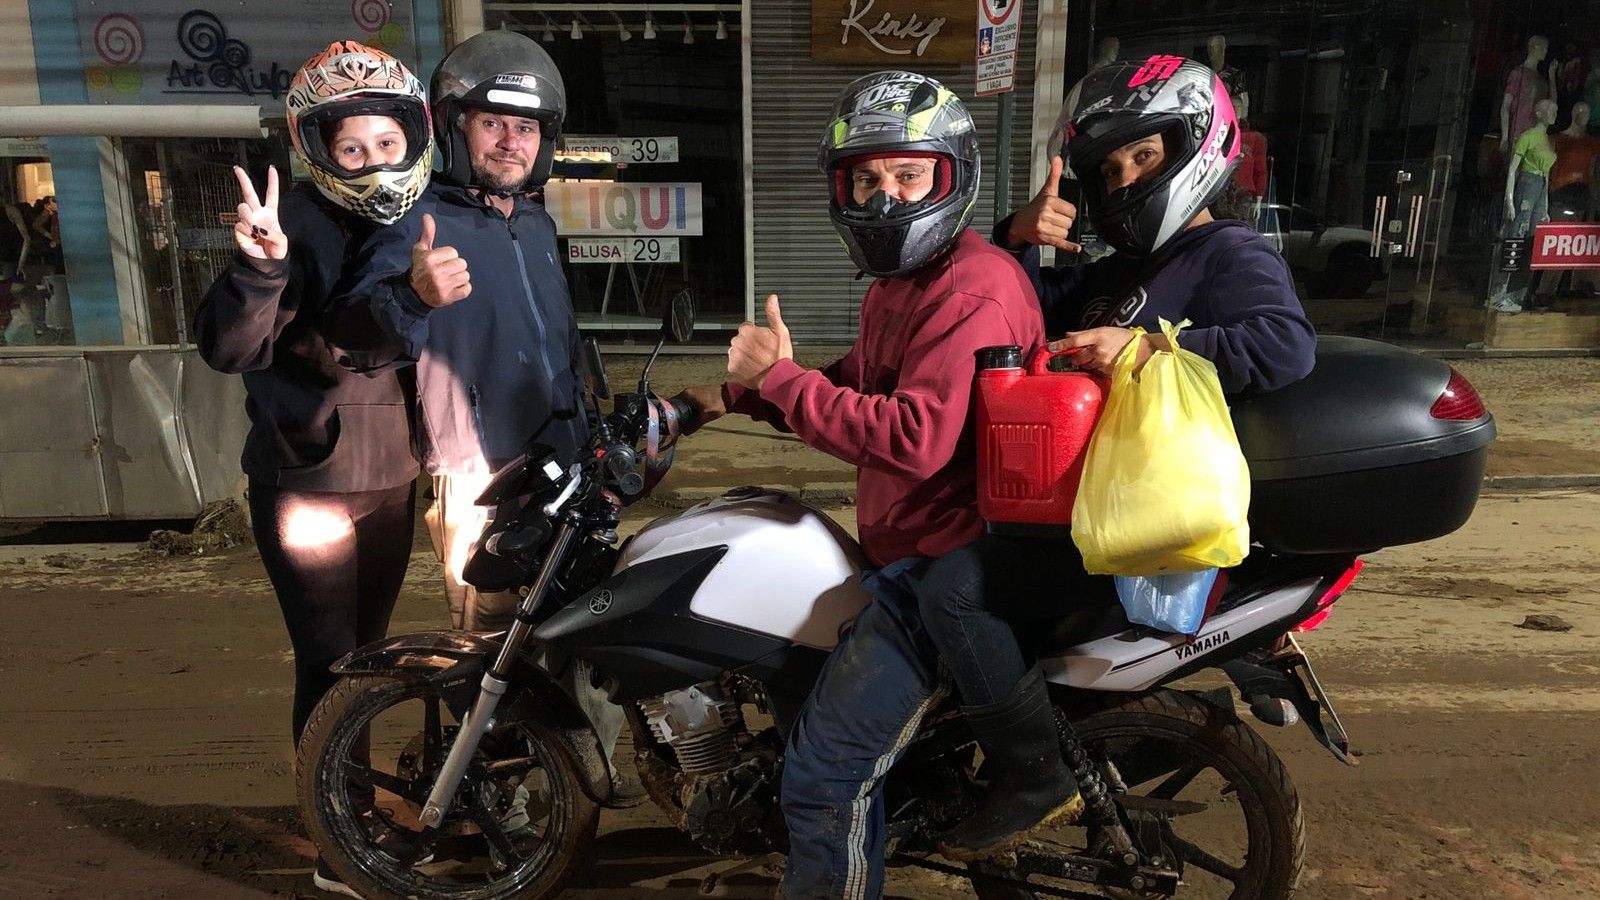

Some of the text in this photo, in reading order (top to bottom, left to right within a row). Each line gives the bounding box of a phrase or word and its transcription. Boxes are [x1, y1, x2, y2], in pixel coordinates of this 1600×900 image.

[166, 59, 205, 87] Art
[631, 138, 659, 162] 39
[561, 186, 687, 233] LIQUI
[570, 245, 622, 258] BLUSA
[633, 238, 661, 261] 29
[1542, 234, 1600, 256] PROM
[1174, 630, 1231, 660] YAMAHA
